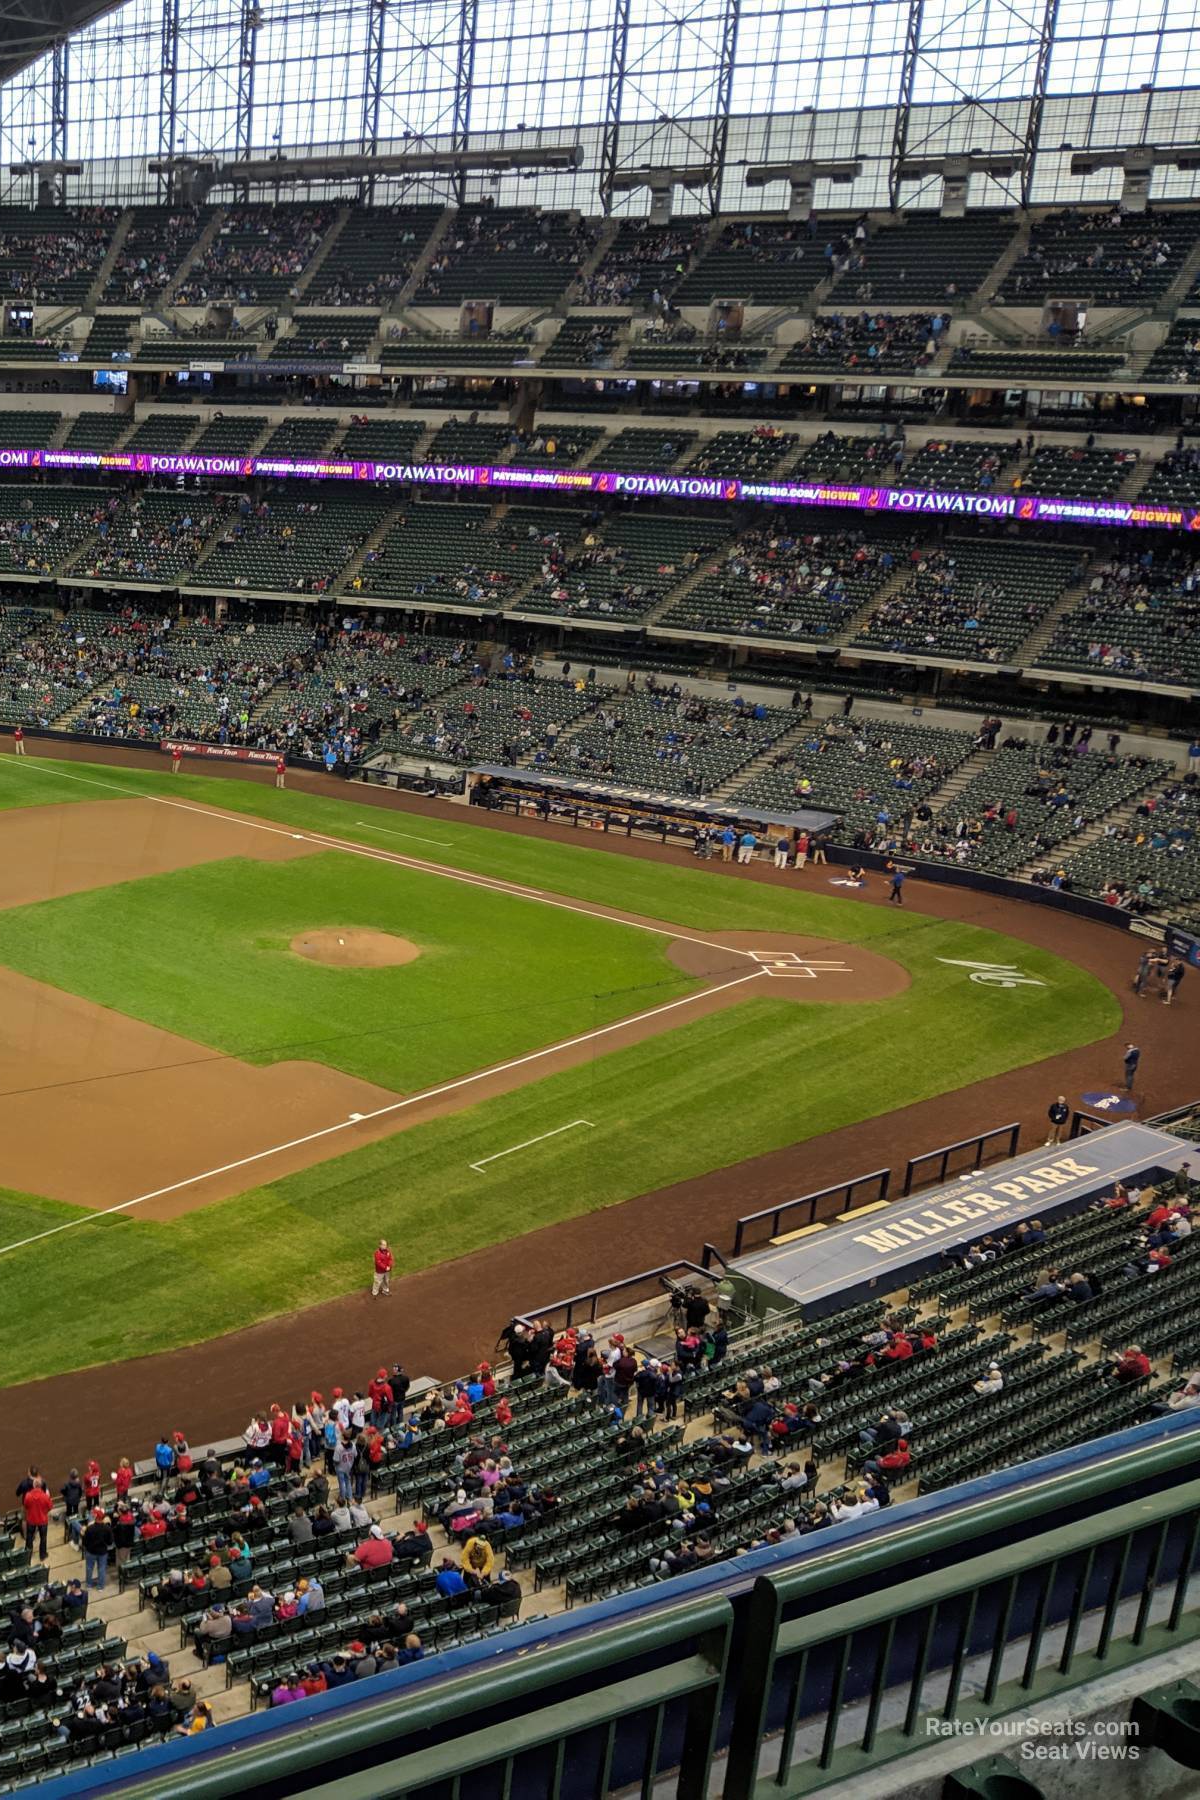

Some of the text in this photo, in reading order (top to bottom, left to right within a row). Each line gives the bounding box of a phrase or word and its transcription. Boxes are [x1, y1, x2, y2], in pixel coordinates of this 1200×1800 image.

[151, 458, 239, 472] POTAWATOMI
[375, 465, 474, 481] POTAWATOMI
[615, 476, 721, 495] POTAWATOMI
[888, 491, 1015, 514] POTAWATOMI
[925, 1179, 988, 1205] WELCOME TO
[853, 1157, 1100, 1254] MILLER PARK
